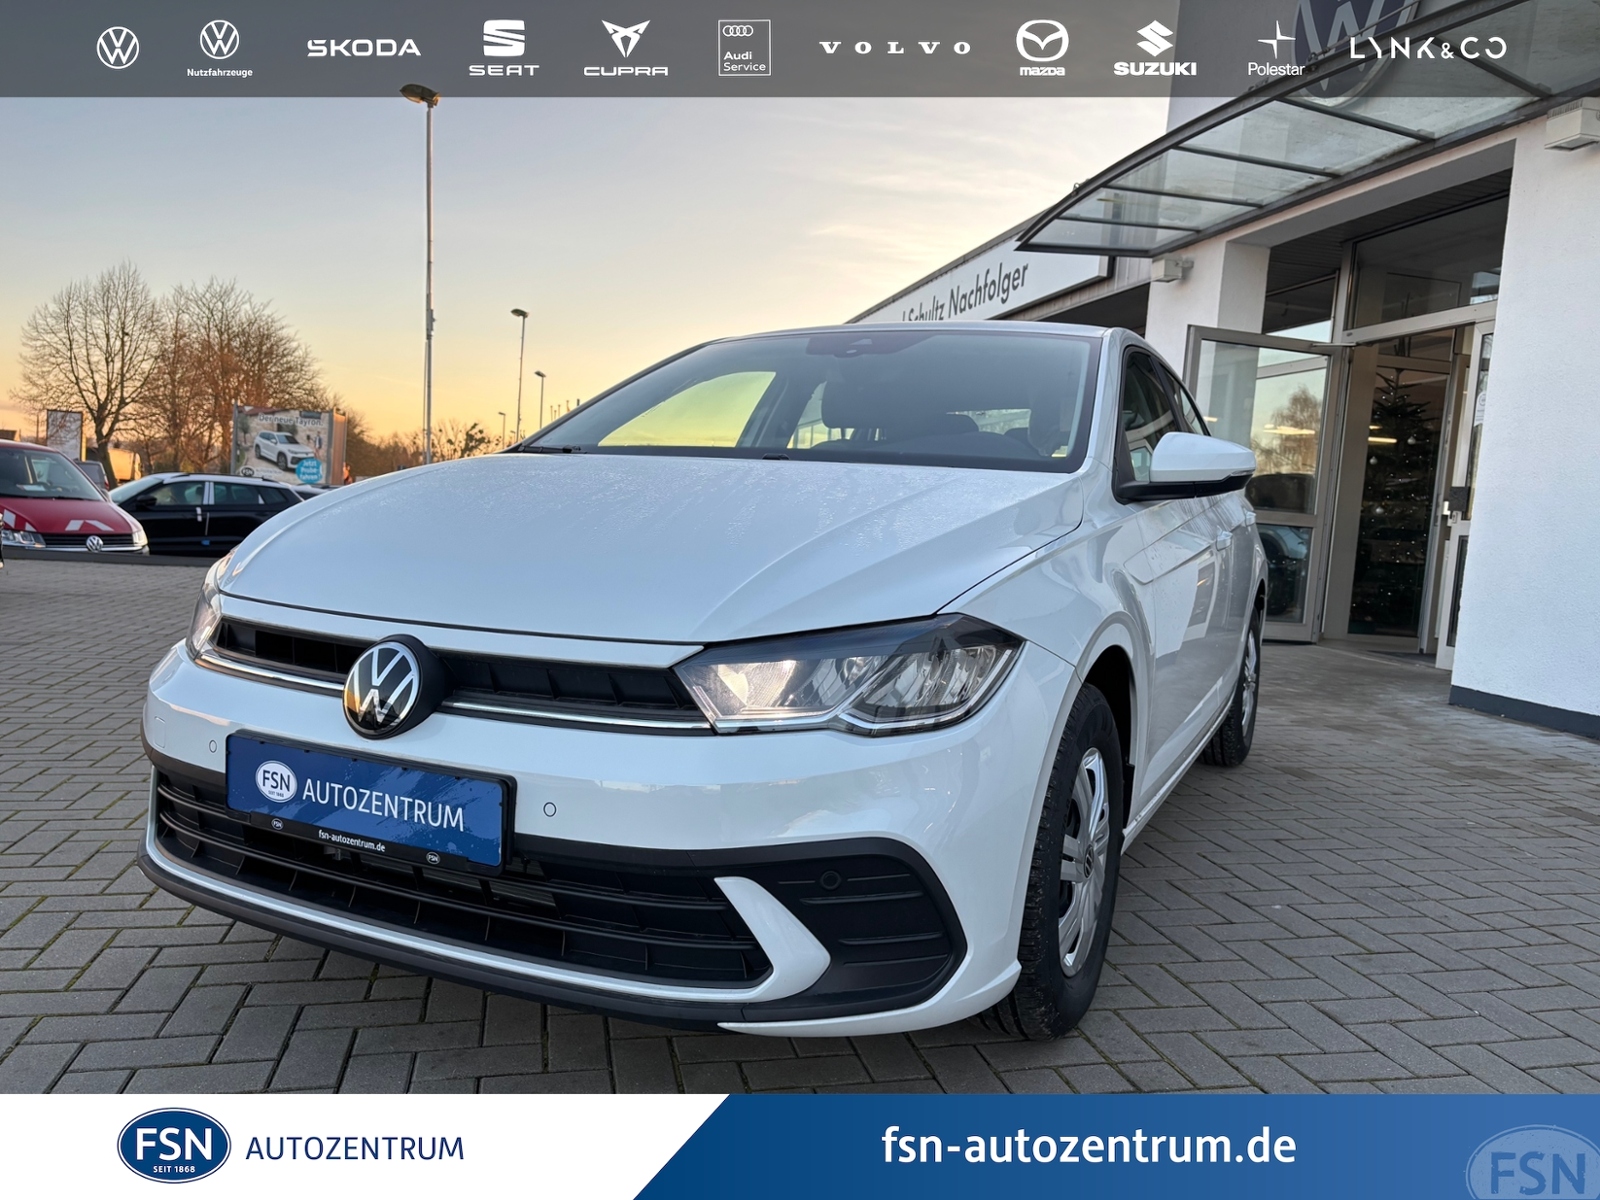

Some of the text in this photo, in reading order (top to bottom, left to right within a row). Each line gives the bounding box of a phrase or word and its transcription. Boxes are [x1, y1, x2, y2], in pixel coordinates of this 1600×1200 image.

[908, 262, 1029, 321] Shultz Nachfolger
[274, 416, 293, 424] neue
[262, 769, 465, 832] FSN AUTOZENTRUM
[318, 829, 386, 853] fsn-autozentrum.de
